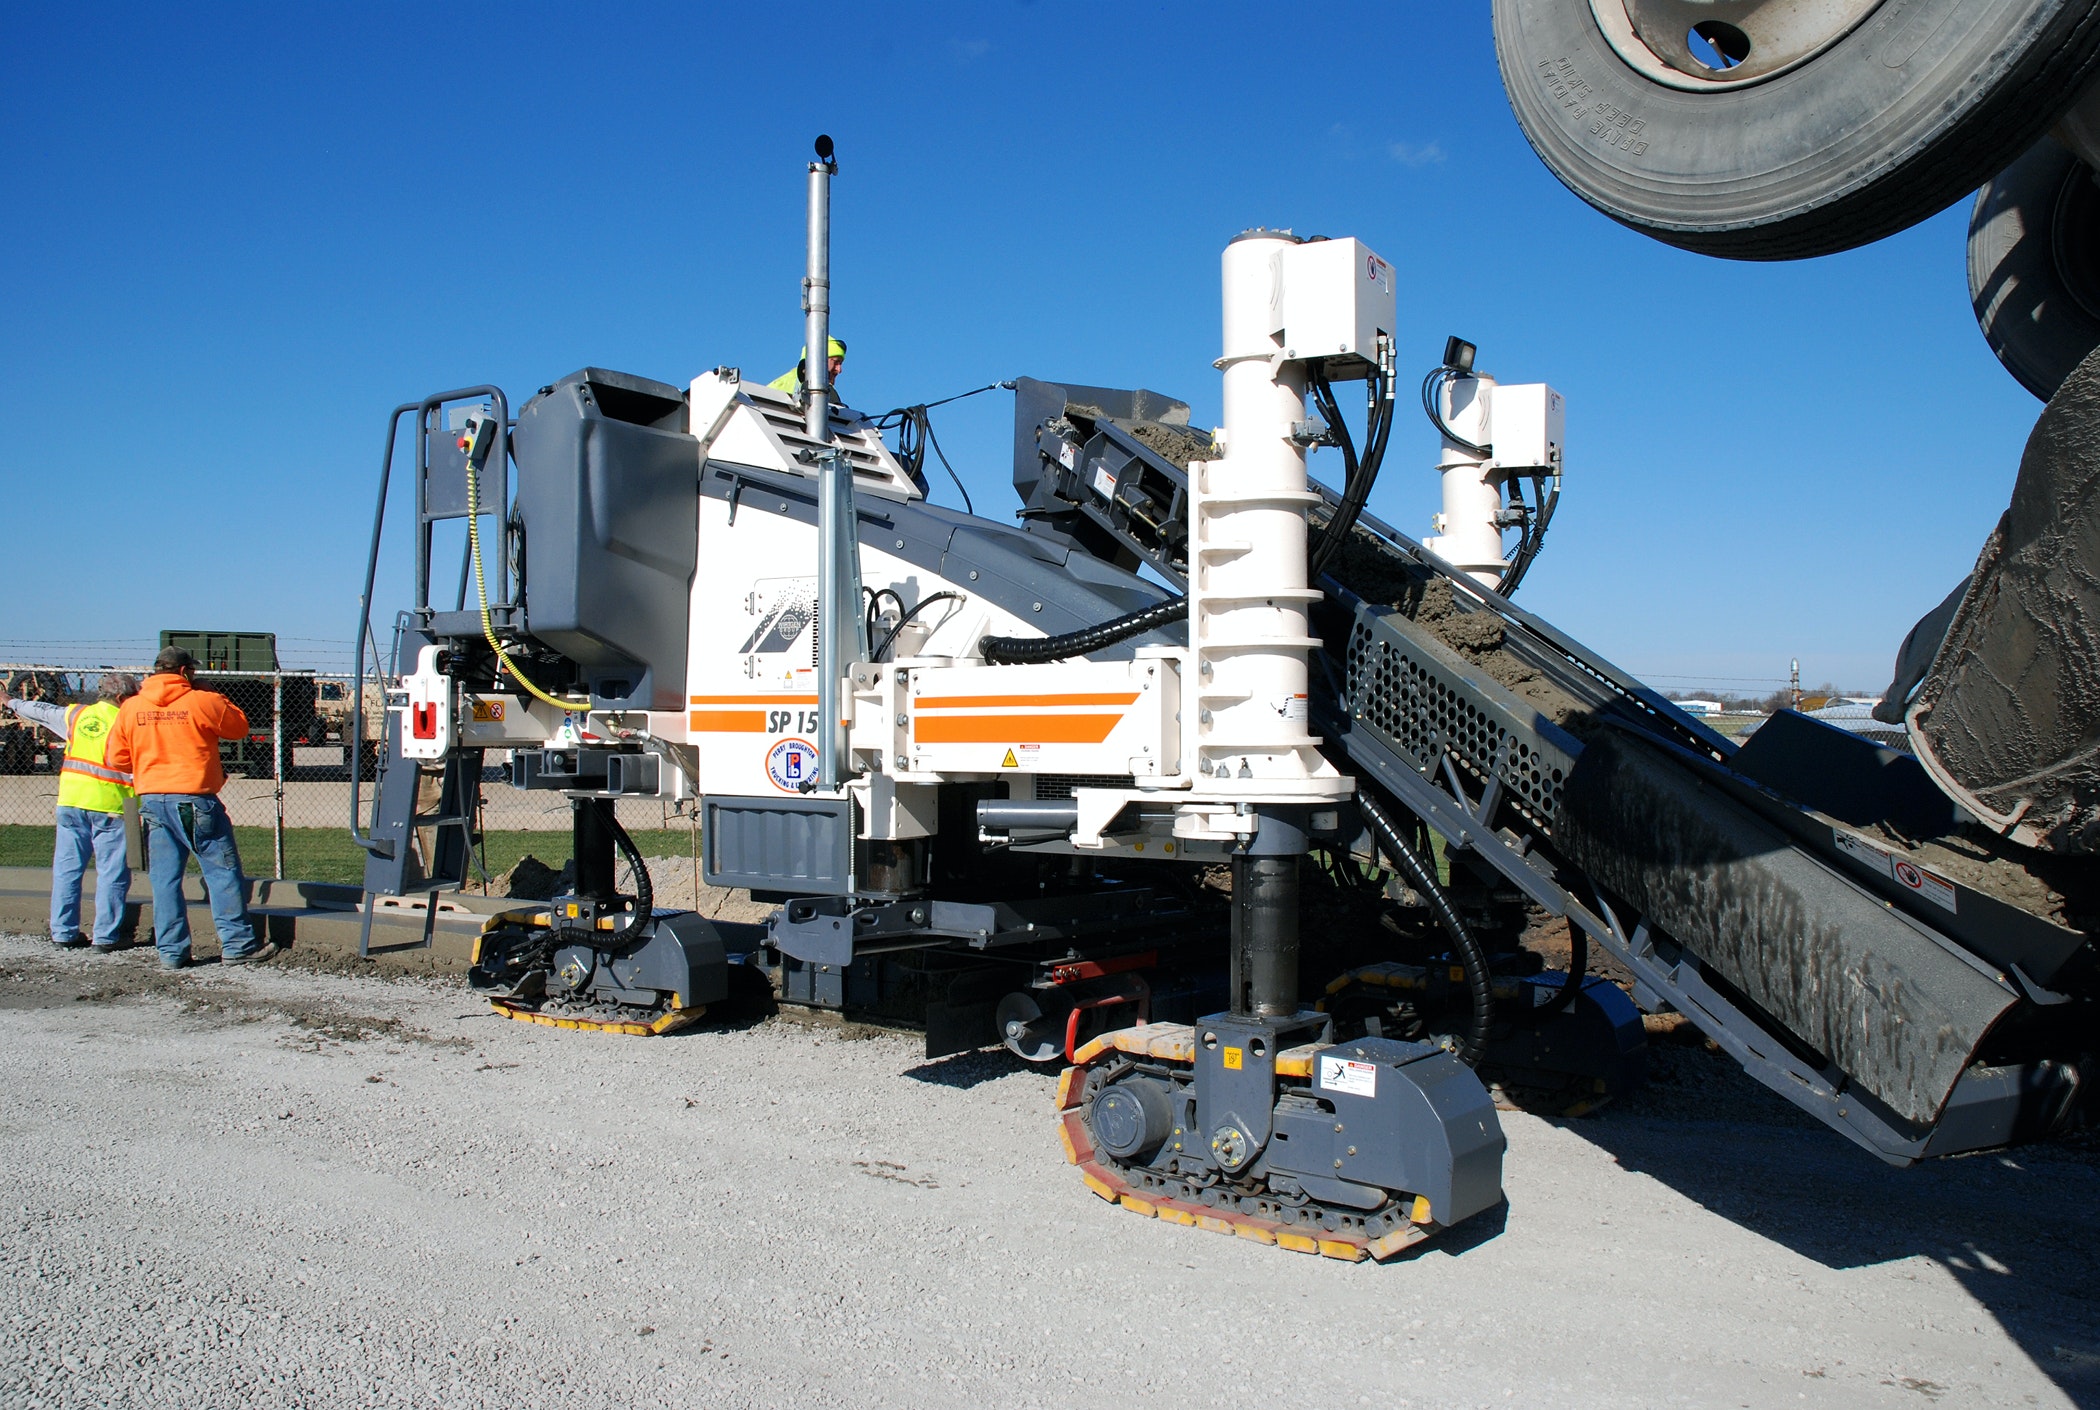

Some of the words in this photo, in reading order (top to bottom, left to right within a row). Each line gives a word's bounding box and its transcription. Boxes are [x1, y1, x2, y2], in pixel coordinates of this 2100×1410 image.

[1537, 56, 1588, 121] RADIAL
[1556, 56, 1593, 100] SKID
[1594, 102, 1648, 135] DEEP
[1590, 119, 1649, 157] DRIVE
[768, 710, 792, 734] SP
[772, 744, 786, 759] PERRY
[789, 742, 816, 760] BROUGHTON
[770, 766, 789, 788] TRUCKING
